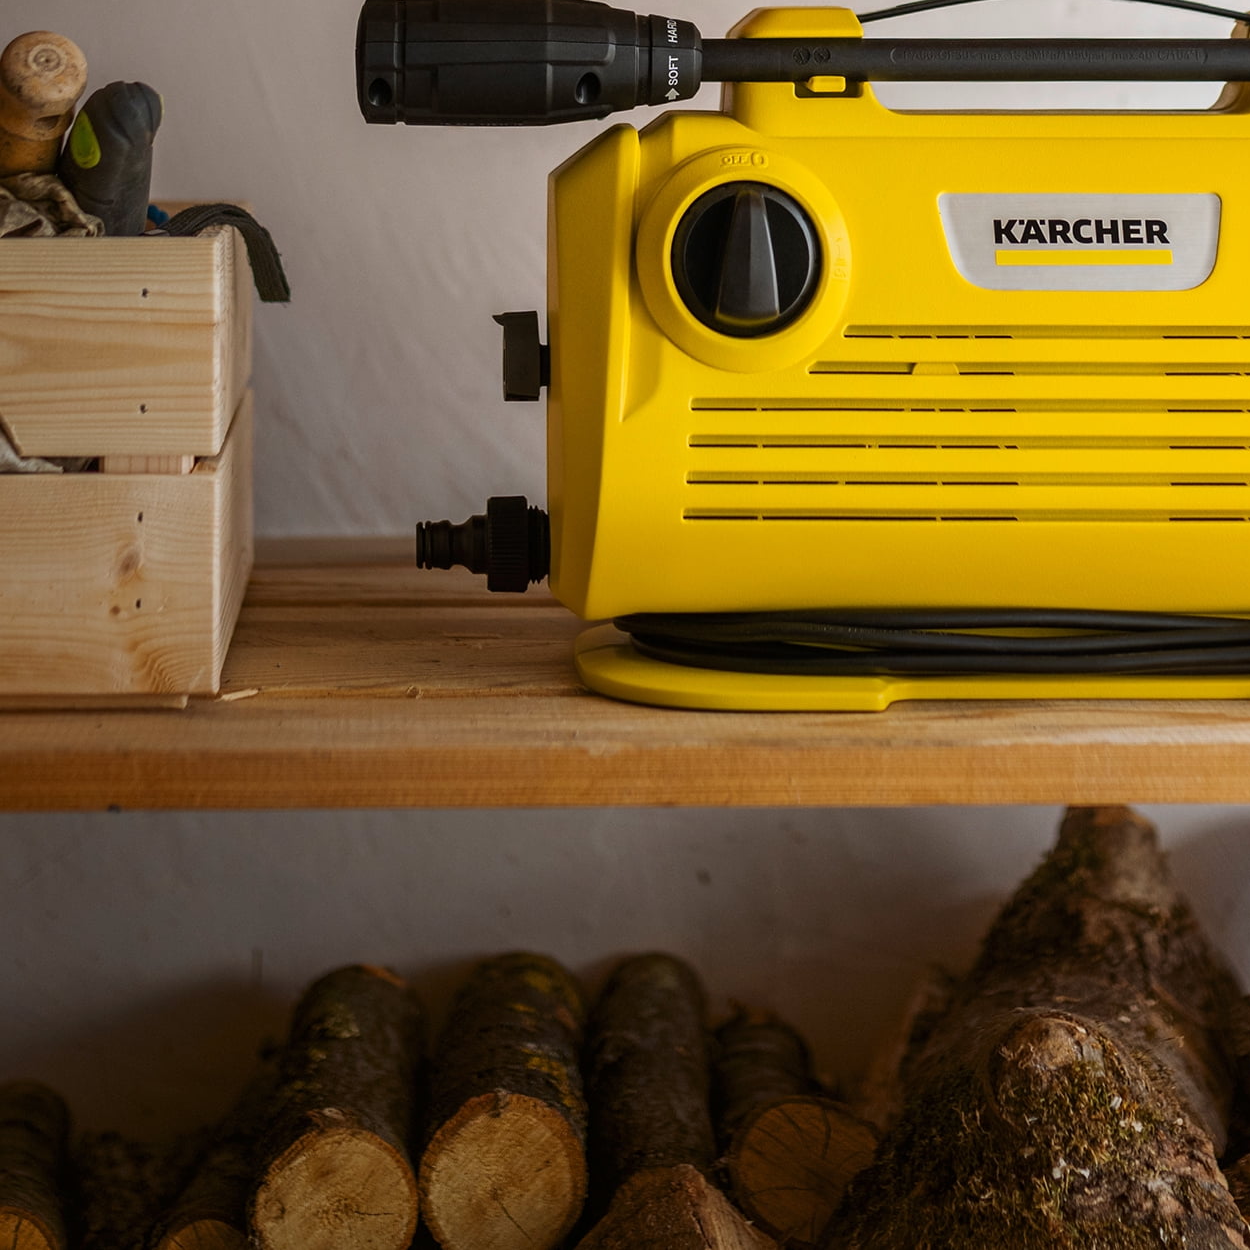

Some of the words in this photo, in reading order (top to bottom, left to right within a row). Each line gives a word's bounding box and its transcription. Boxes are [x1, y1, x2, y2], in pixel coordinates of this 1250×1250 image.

[667, 20, 678, 43] HARD
[668, 55, 679, 86] SOFT
[993, 219, 1170, 244] KÄRCHER
